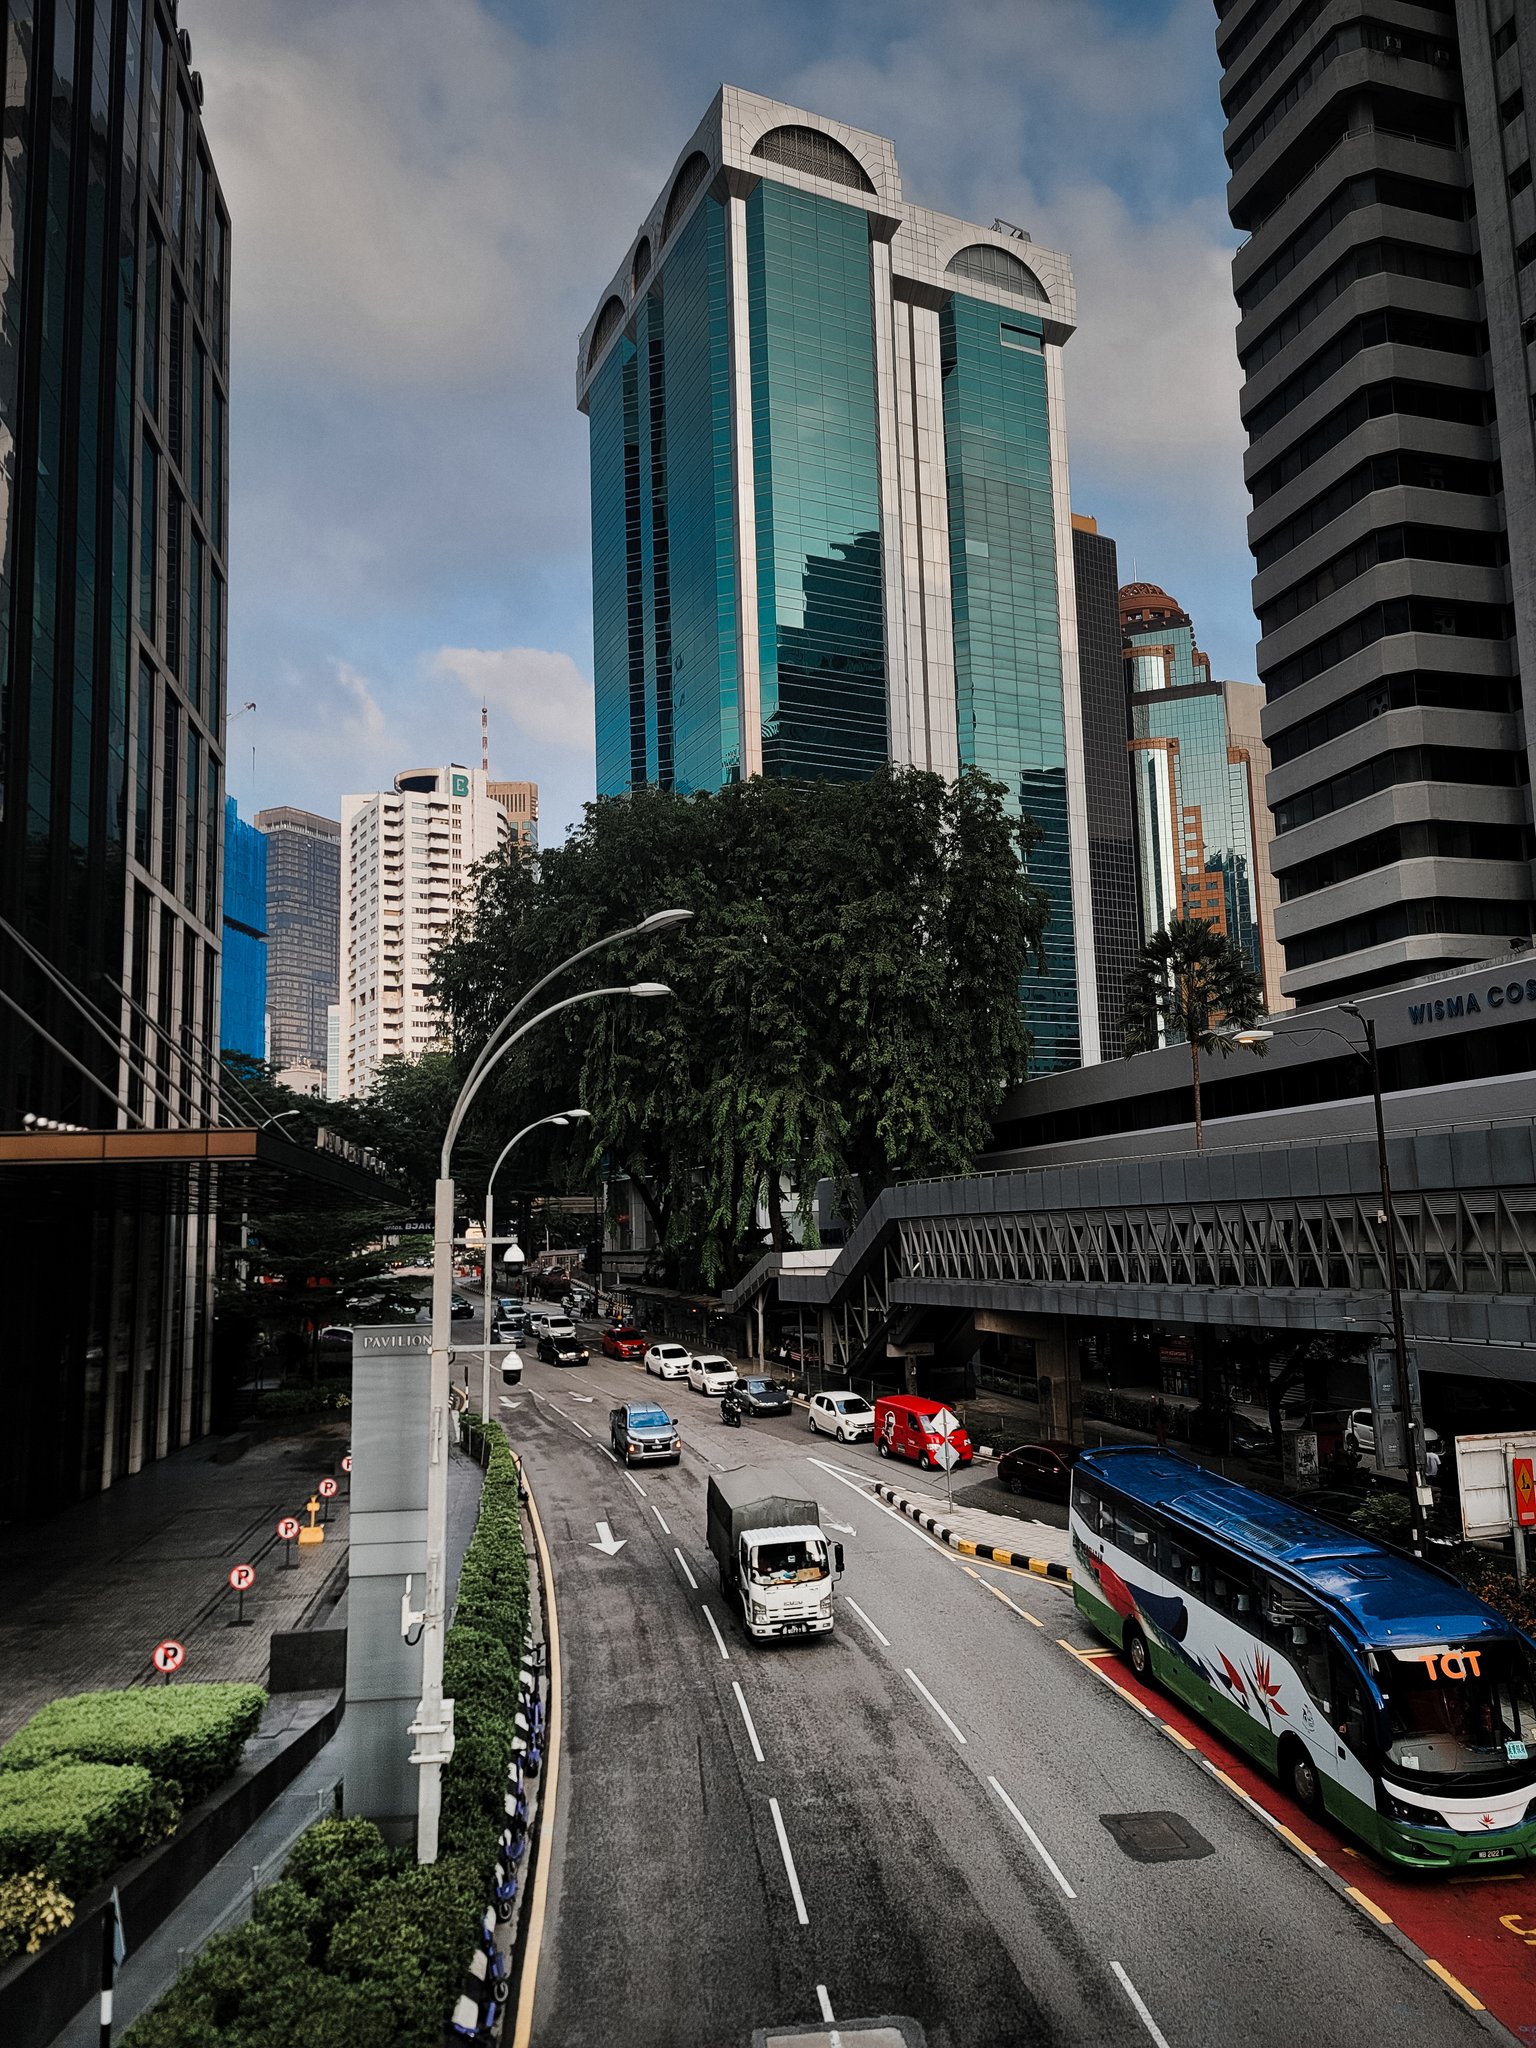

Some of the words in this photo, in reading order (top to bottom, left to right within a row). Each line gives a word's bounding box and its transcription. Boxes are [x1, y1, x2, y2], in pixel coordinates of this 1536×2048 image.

[1407, 993, 1482, 1025] WISMA
[1487, 978, 1536, 1008] COS
[363, 1334, 433, 1349] PAVILION
[324, 1482, 333, 1494] P
[285, 1522, 294, 1535] P
[237, 1569, 249, 1585] P
[163, 1646, 178, 1667] P
[1419, 1651, 1482, 1681] TCT
